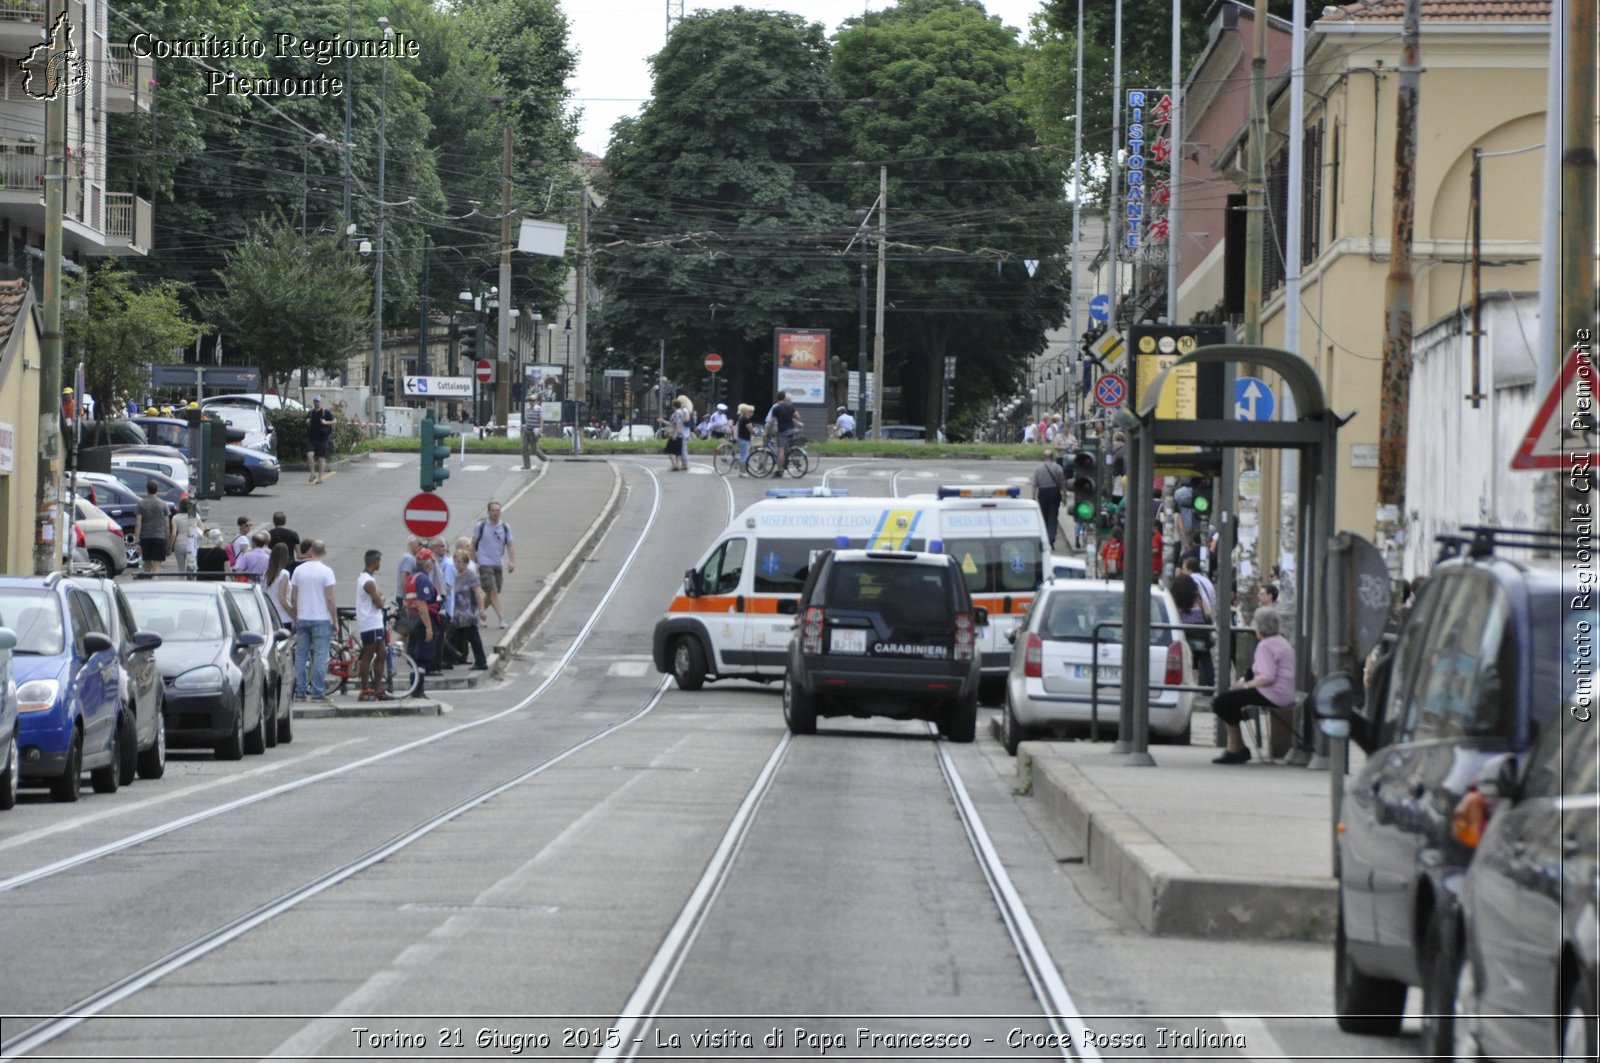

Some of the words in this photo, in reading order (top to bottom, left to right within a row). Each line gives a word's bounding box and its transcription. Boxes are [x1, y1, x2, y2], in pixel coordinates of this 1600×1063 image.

[1127, 91, 1145, 248] RISTORANTE
[761, 514, 825, 528] MISERICORDIA
[826, 514, 875, 528] COLLEGNO
[874, 642, 947, 656] CARABINIERI
